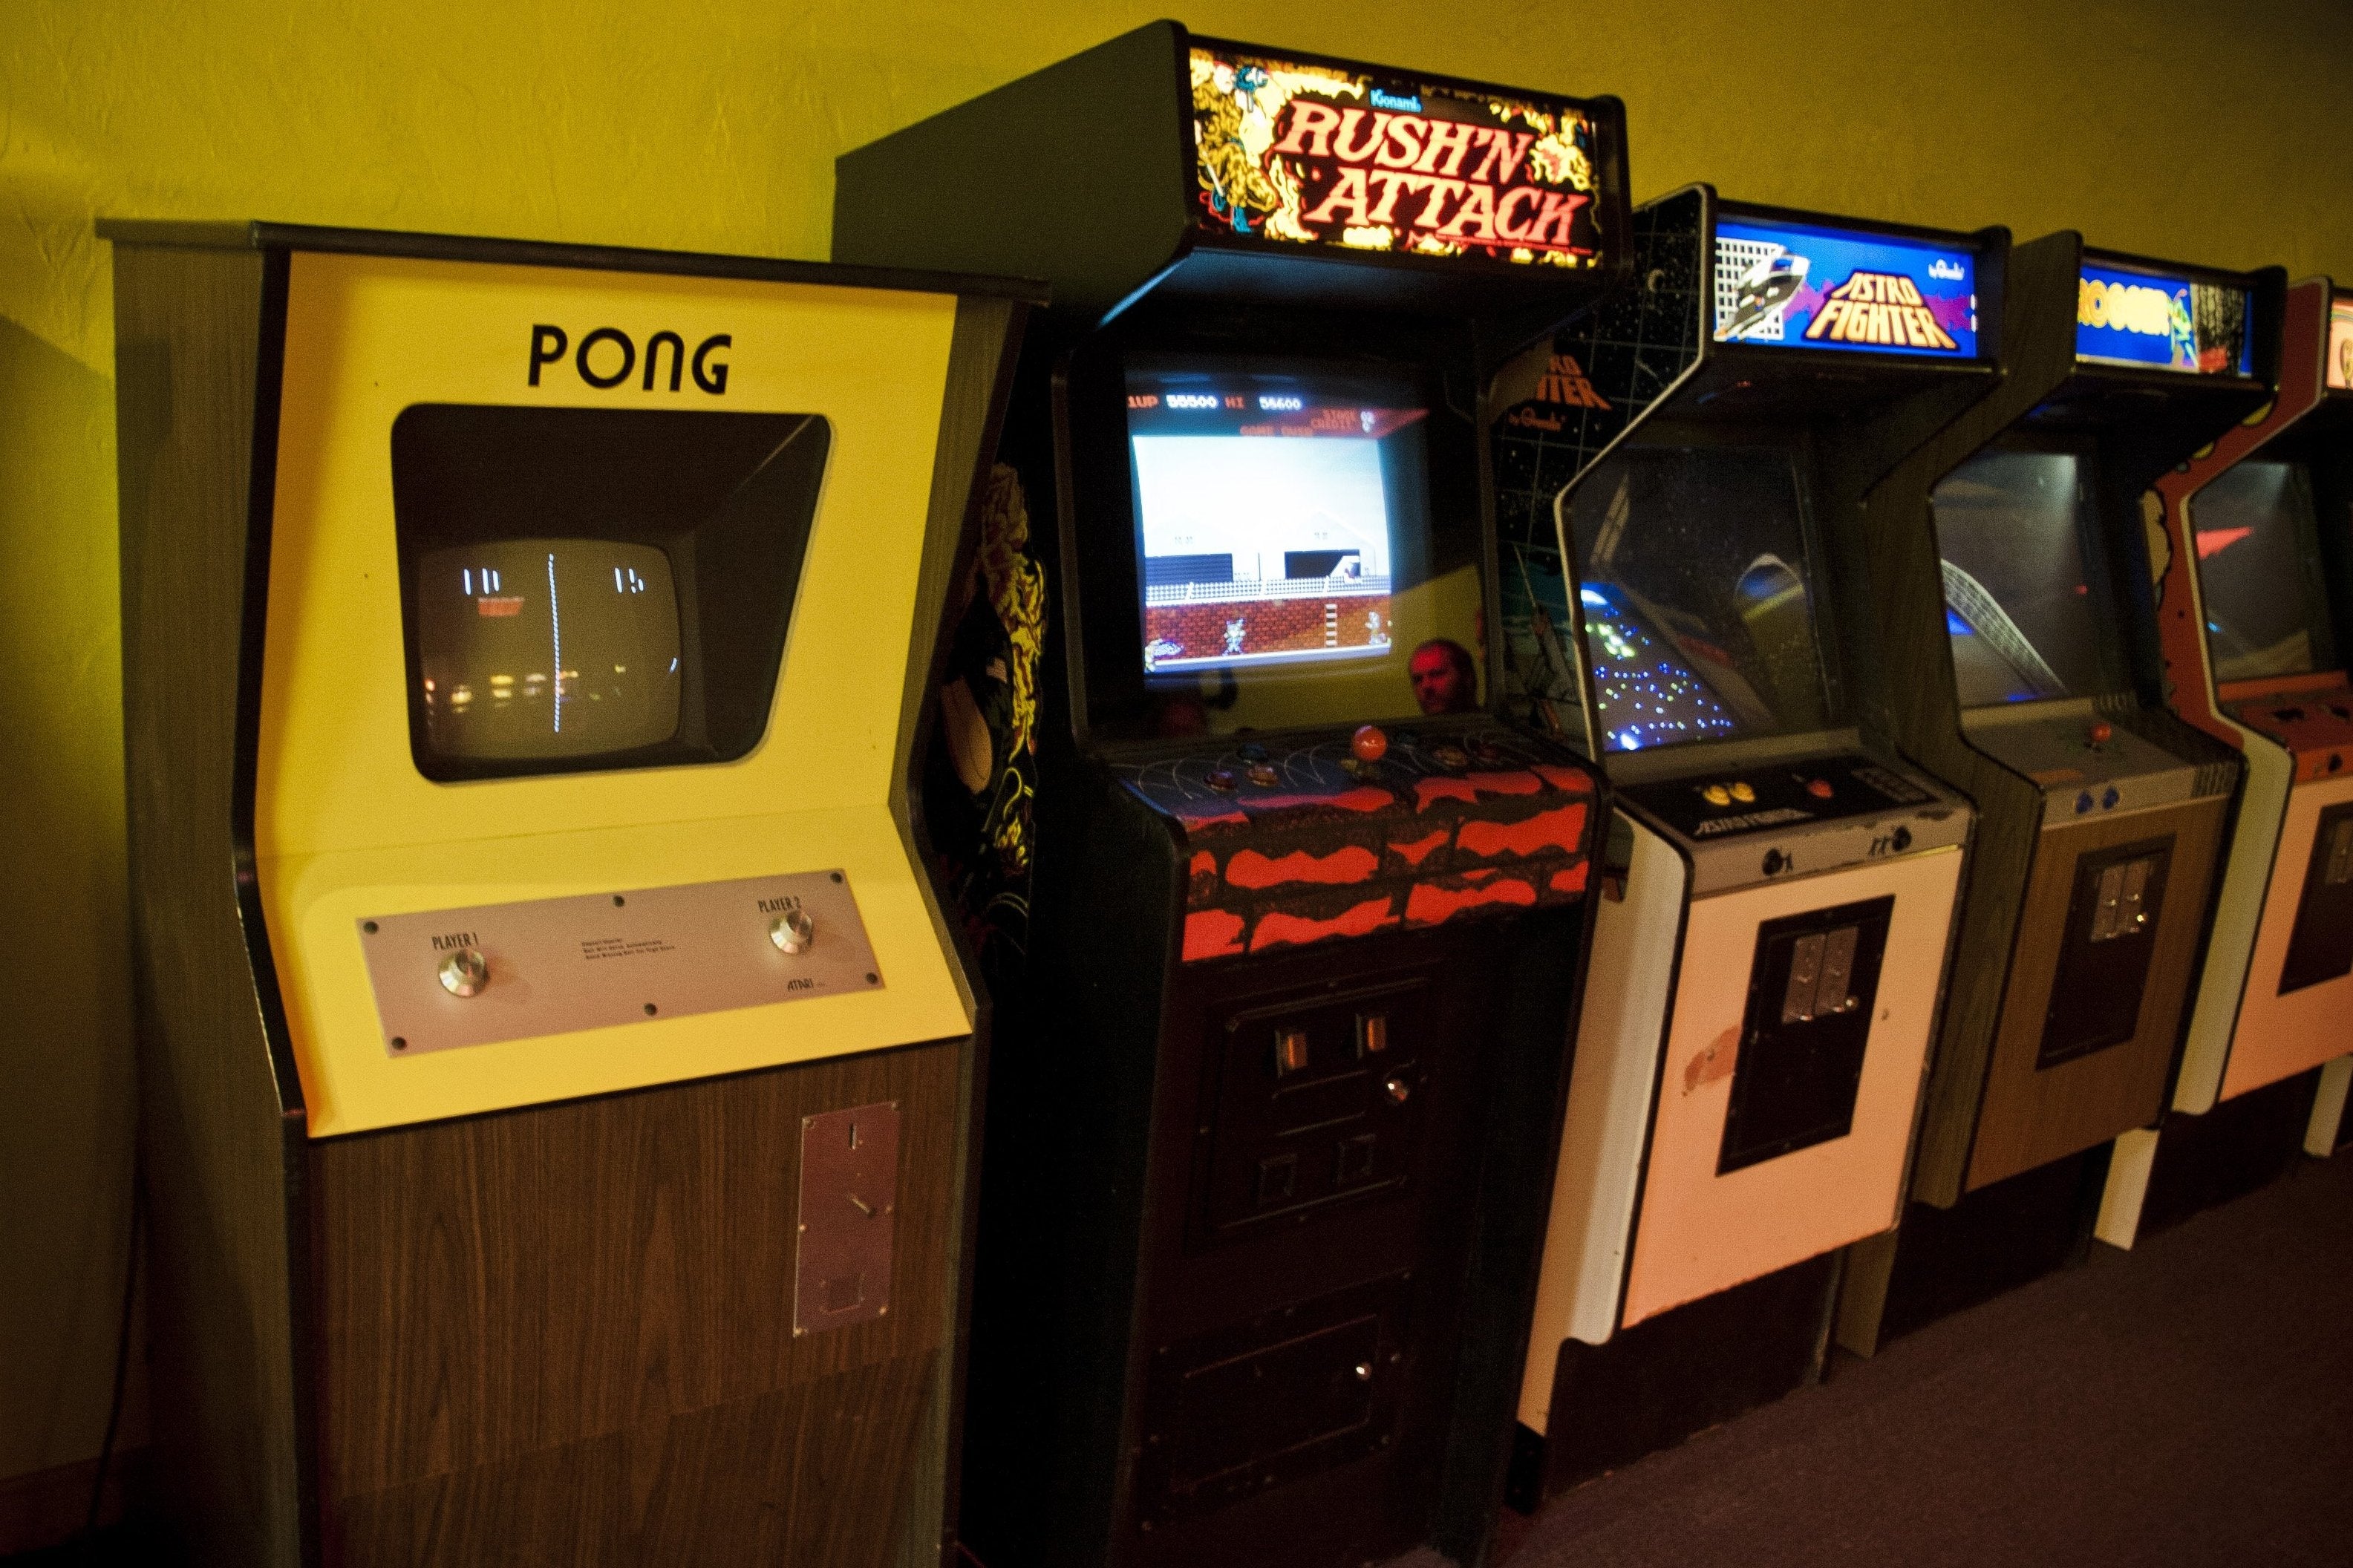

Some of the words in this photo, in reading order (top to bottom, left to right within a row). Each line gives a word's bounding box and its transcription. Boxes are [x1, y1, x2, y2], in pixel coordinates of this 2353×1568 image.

[1370, 88, 1421, 113] Konami
[1273, 99, 1536, 186] RUSH'N
[1303, 166, 1593, 246] ATTACK
[1832, 272, 1923, 306] ASTRO
[1806, 299, 1958, 350] FIGHTER
[528, 324, 732, 395] PONG
[758, 896, 793, 913] PLAYER
[794, 896, 802, 909] 2
[431, 933, 471, 951] PLAYER
[472, 932, 479, 947] 1
[787, 978, 815, 992] ATARI
